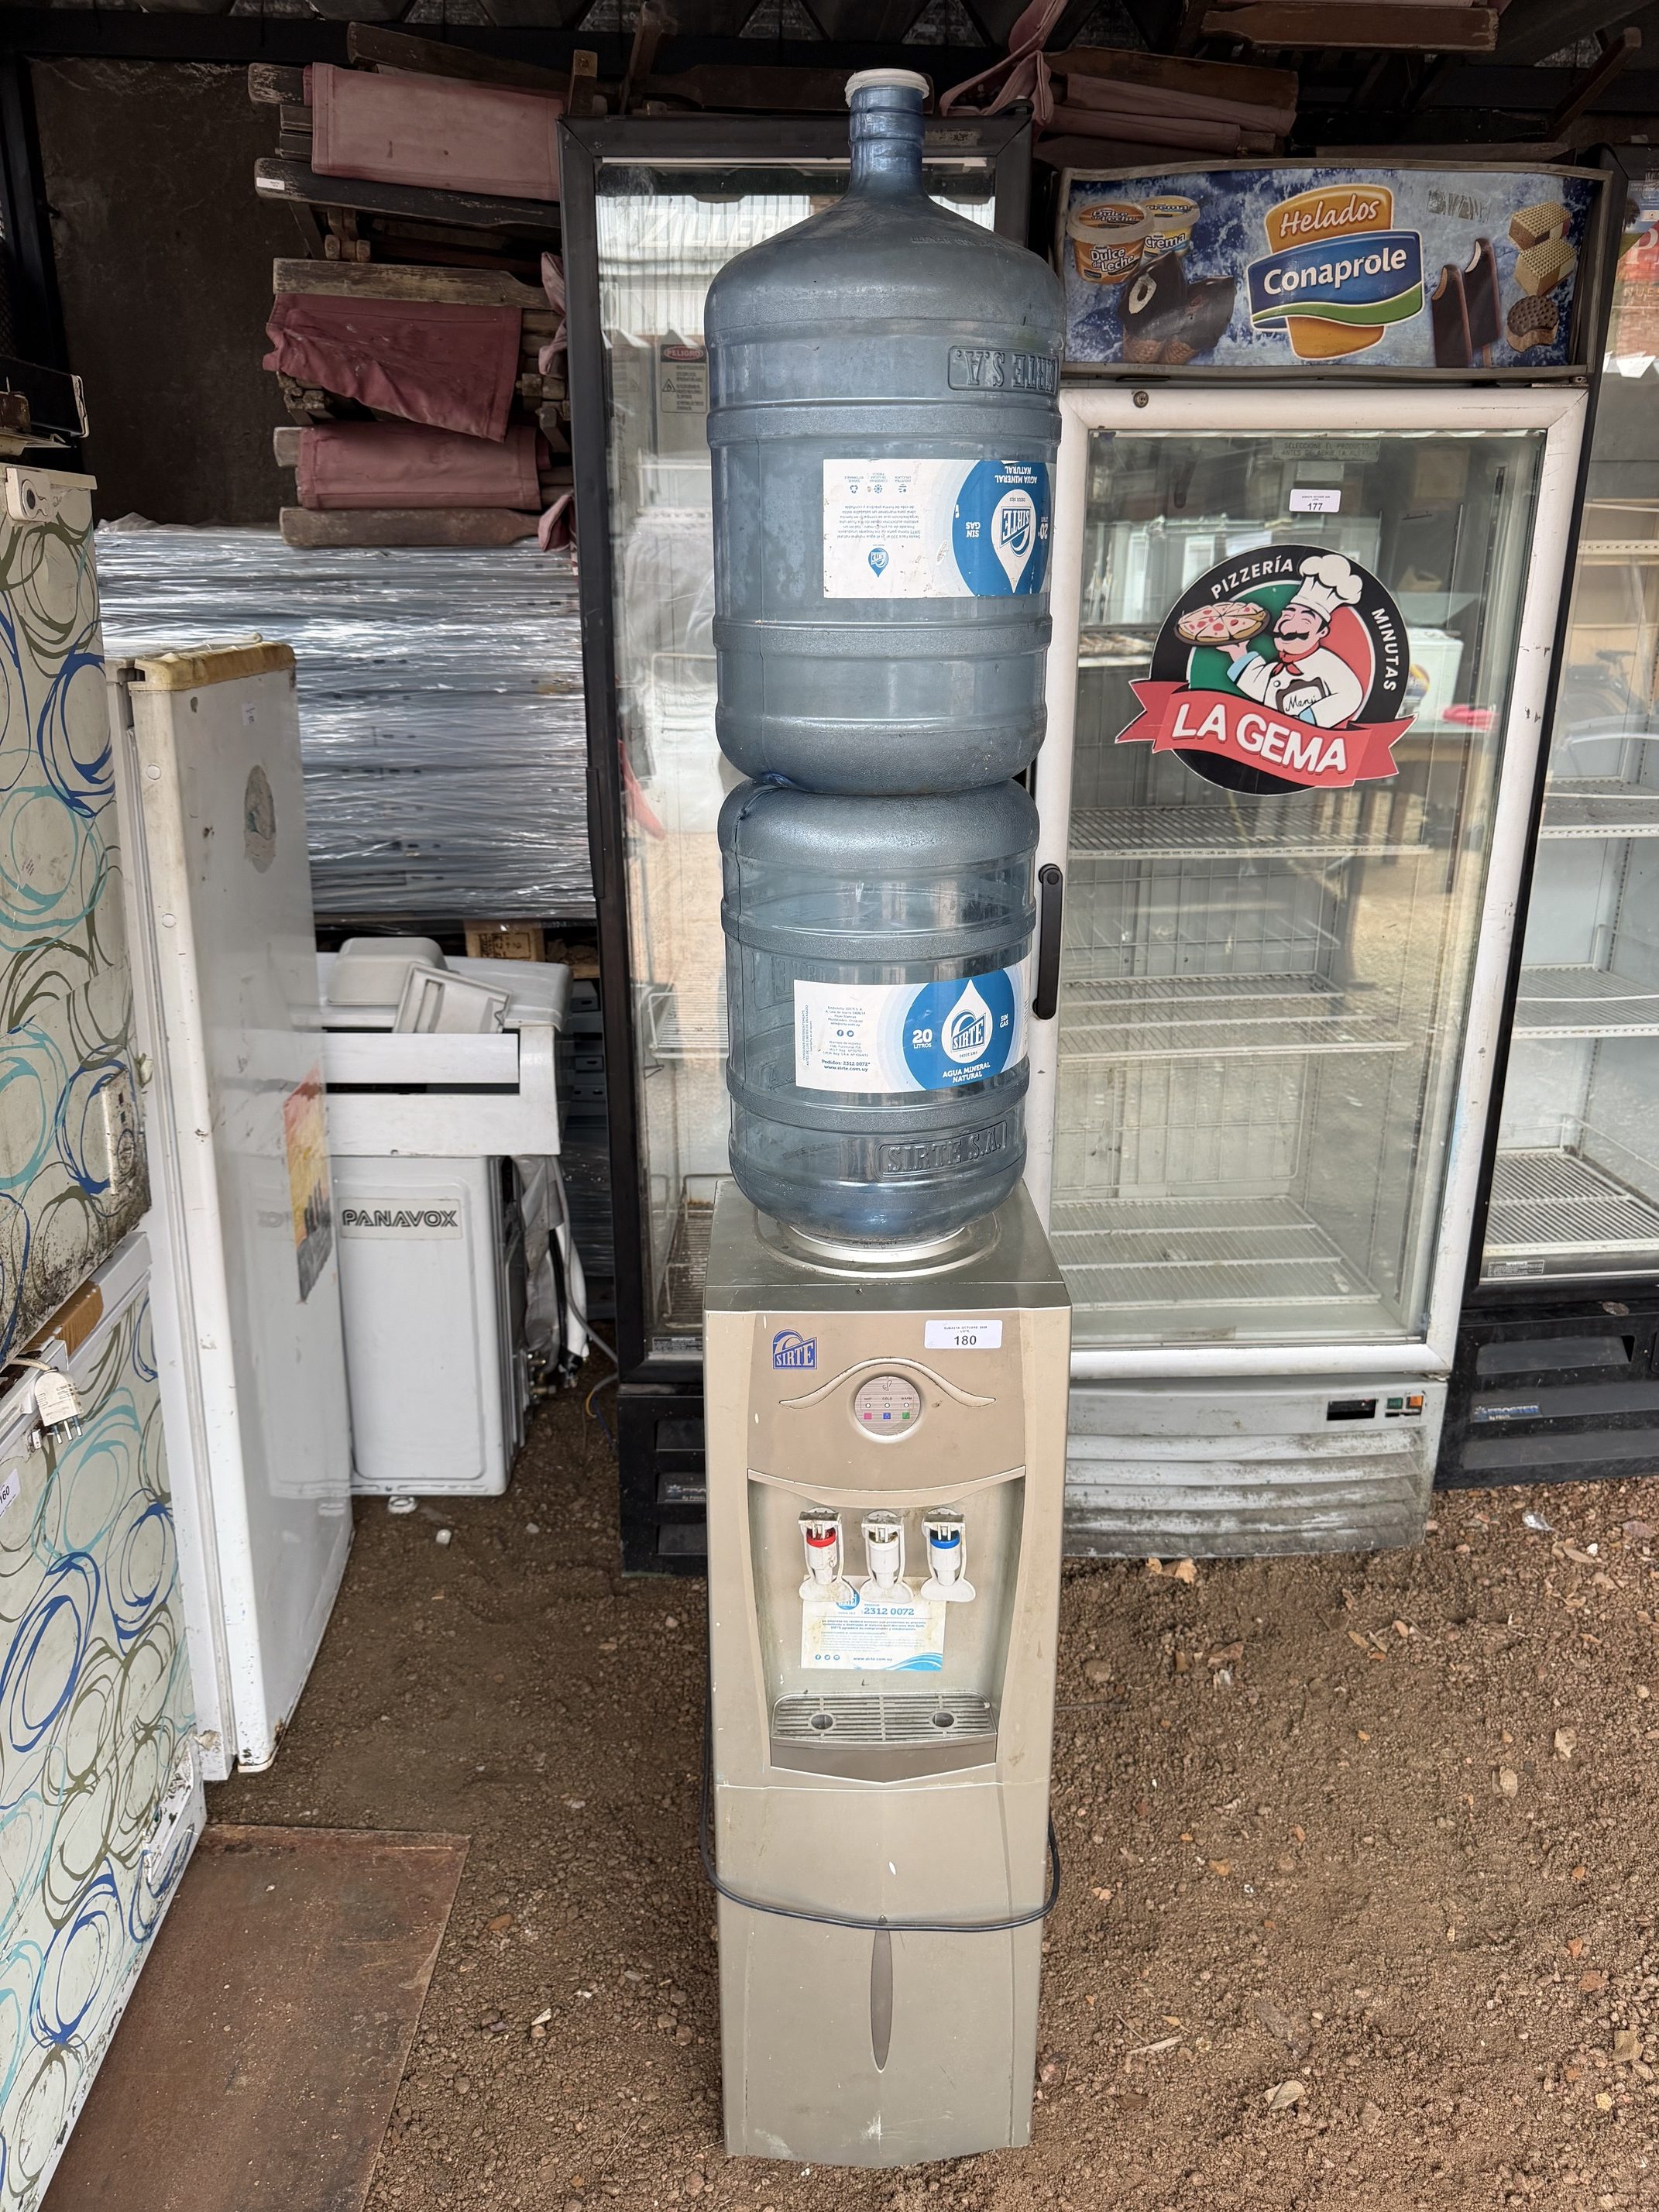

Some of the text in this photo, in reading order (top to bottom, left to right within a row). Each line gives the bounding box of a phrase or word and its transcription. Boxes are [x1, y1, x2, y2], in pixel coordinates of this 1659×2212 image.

[1279, 194, 1378, 238] Helados
[1145, 234, 1186, 248] Crema
[1625, 227, 1659, 265] P
[1091, 249, 1125, 261] Dulce
[1101, 256, 1134, 272] Leche
[1263, 247, 1407, 297] Conaprole
[994, 475, 1022, 483] MINERAL
[1002, 510, 1029, 541] SIRTE
[1210, 555, 1293, 599] PIZZERÍA
[1371, 608, 1400, 692] MINUTAS
[1285, 696, 1319, 712] Menú
[1172, 703, 1348, 774] LA GEMA
[1000, 1020, 1009, 1029] GAS
[912, 1029, 933, 1044] 20
[953, 1022, 984, 1050] SIRTE
[943, 1062, 991, 1078] AGUA MINERAL
[952, 1071, 983, 1084] NATURAL
[887, 1139, 963, 1173] SIRTE
[342, 1209, 459, 1228] PANAVOX
[954, 1335, 977, 1345] 180
[776, 1345, 813, 1367] SIRTE
